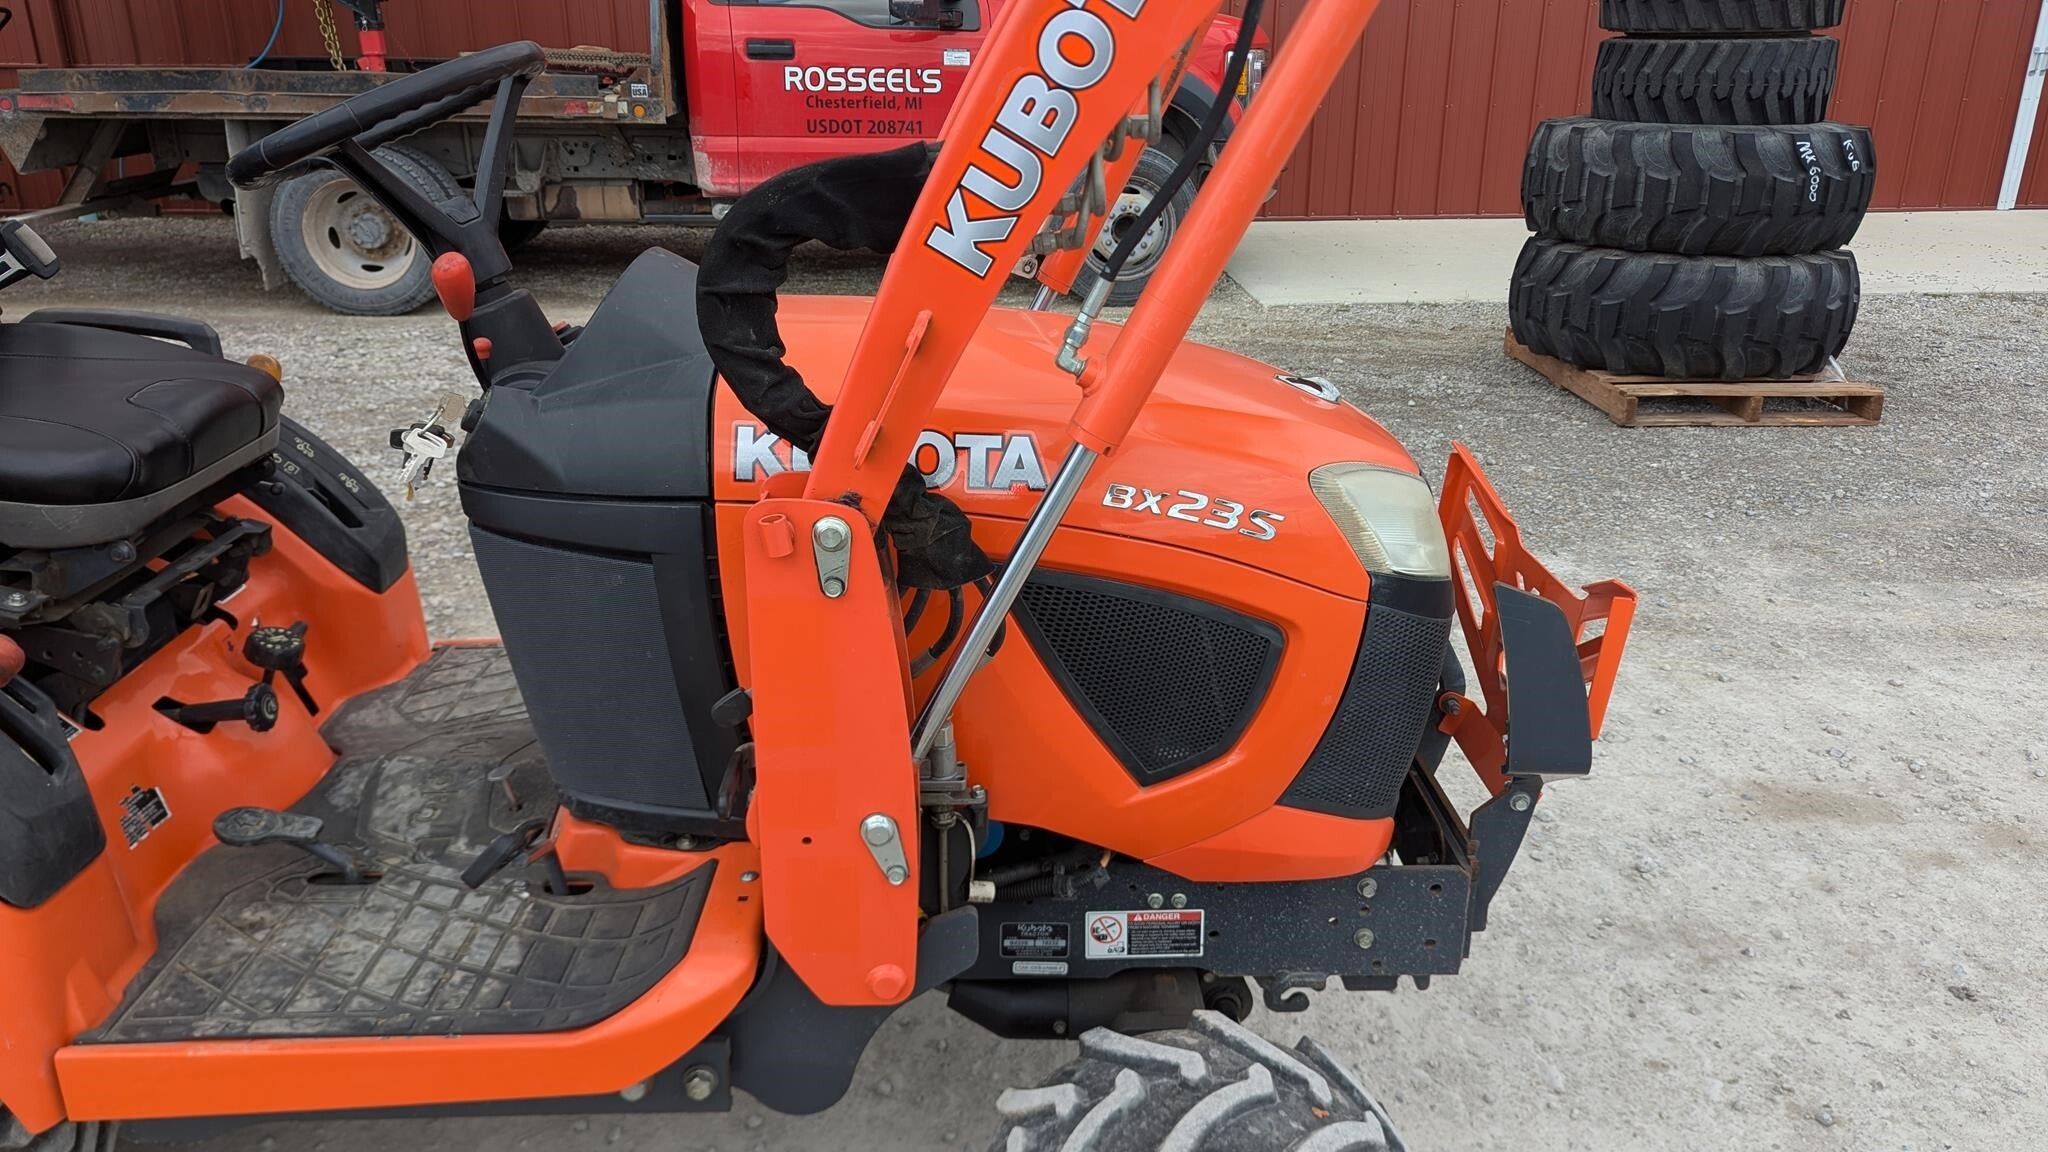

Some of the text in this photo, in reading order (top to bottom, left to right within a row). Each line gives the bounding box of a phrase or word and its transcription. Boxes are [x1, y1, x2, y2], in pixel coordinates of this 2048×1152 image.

[783, 66, 943, 94] ROSSEEL'S
[632, 87, 648, 97] USA
[806, 95, 923, 111] Chesterfield, MI
[806, 119, 923, 135] USDOT 208741
[927, 0, 1146, 280] KUBO
[734, 425, 1047, 490] KOTA
[1102, 483, 1286, 541] BX23S
[1143, 912, 1181, 921] DANGER
